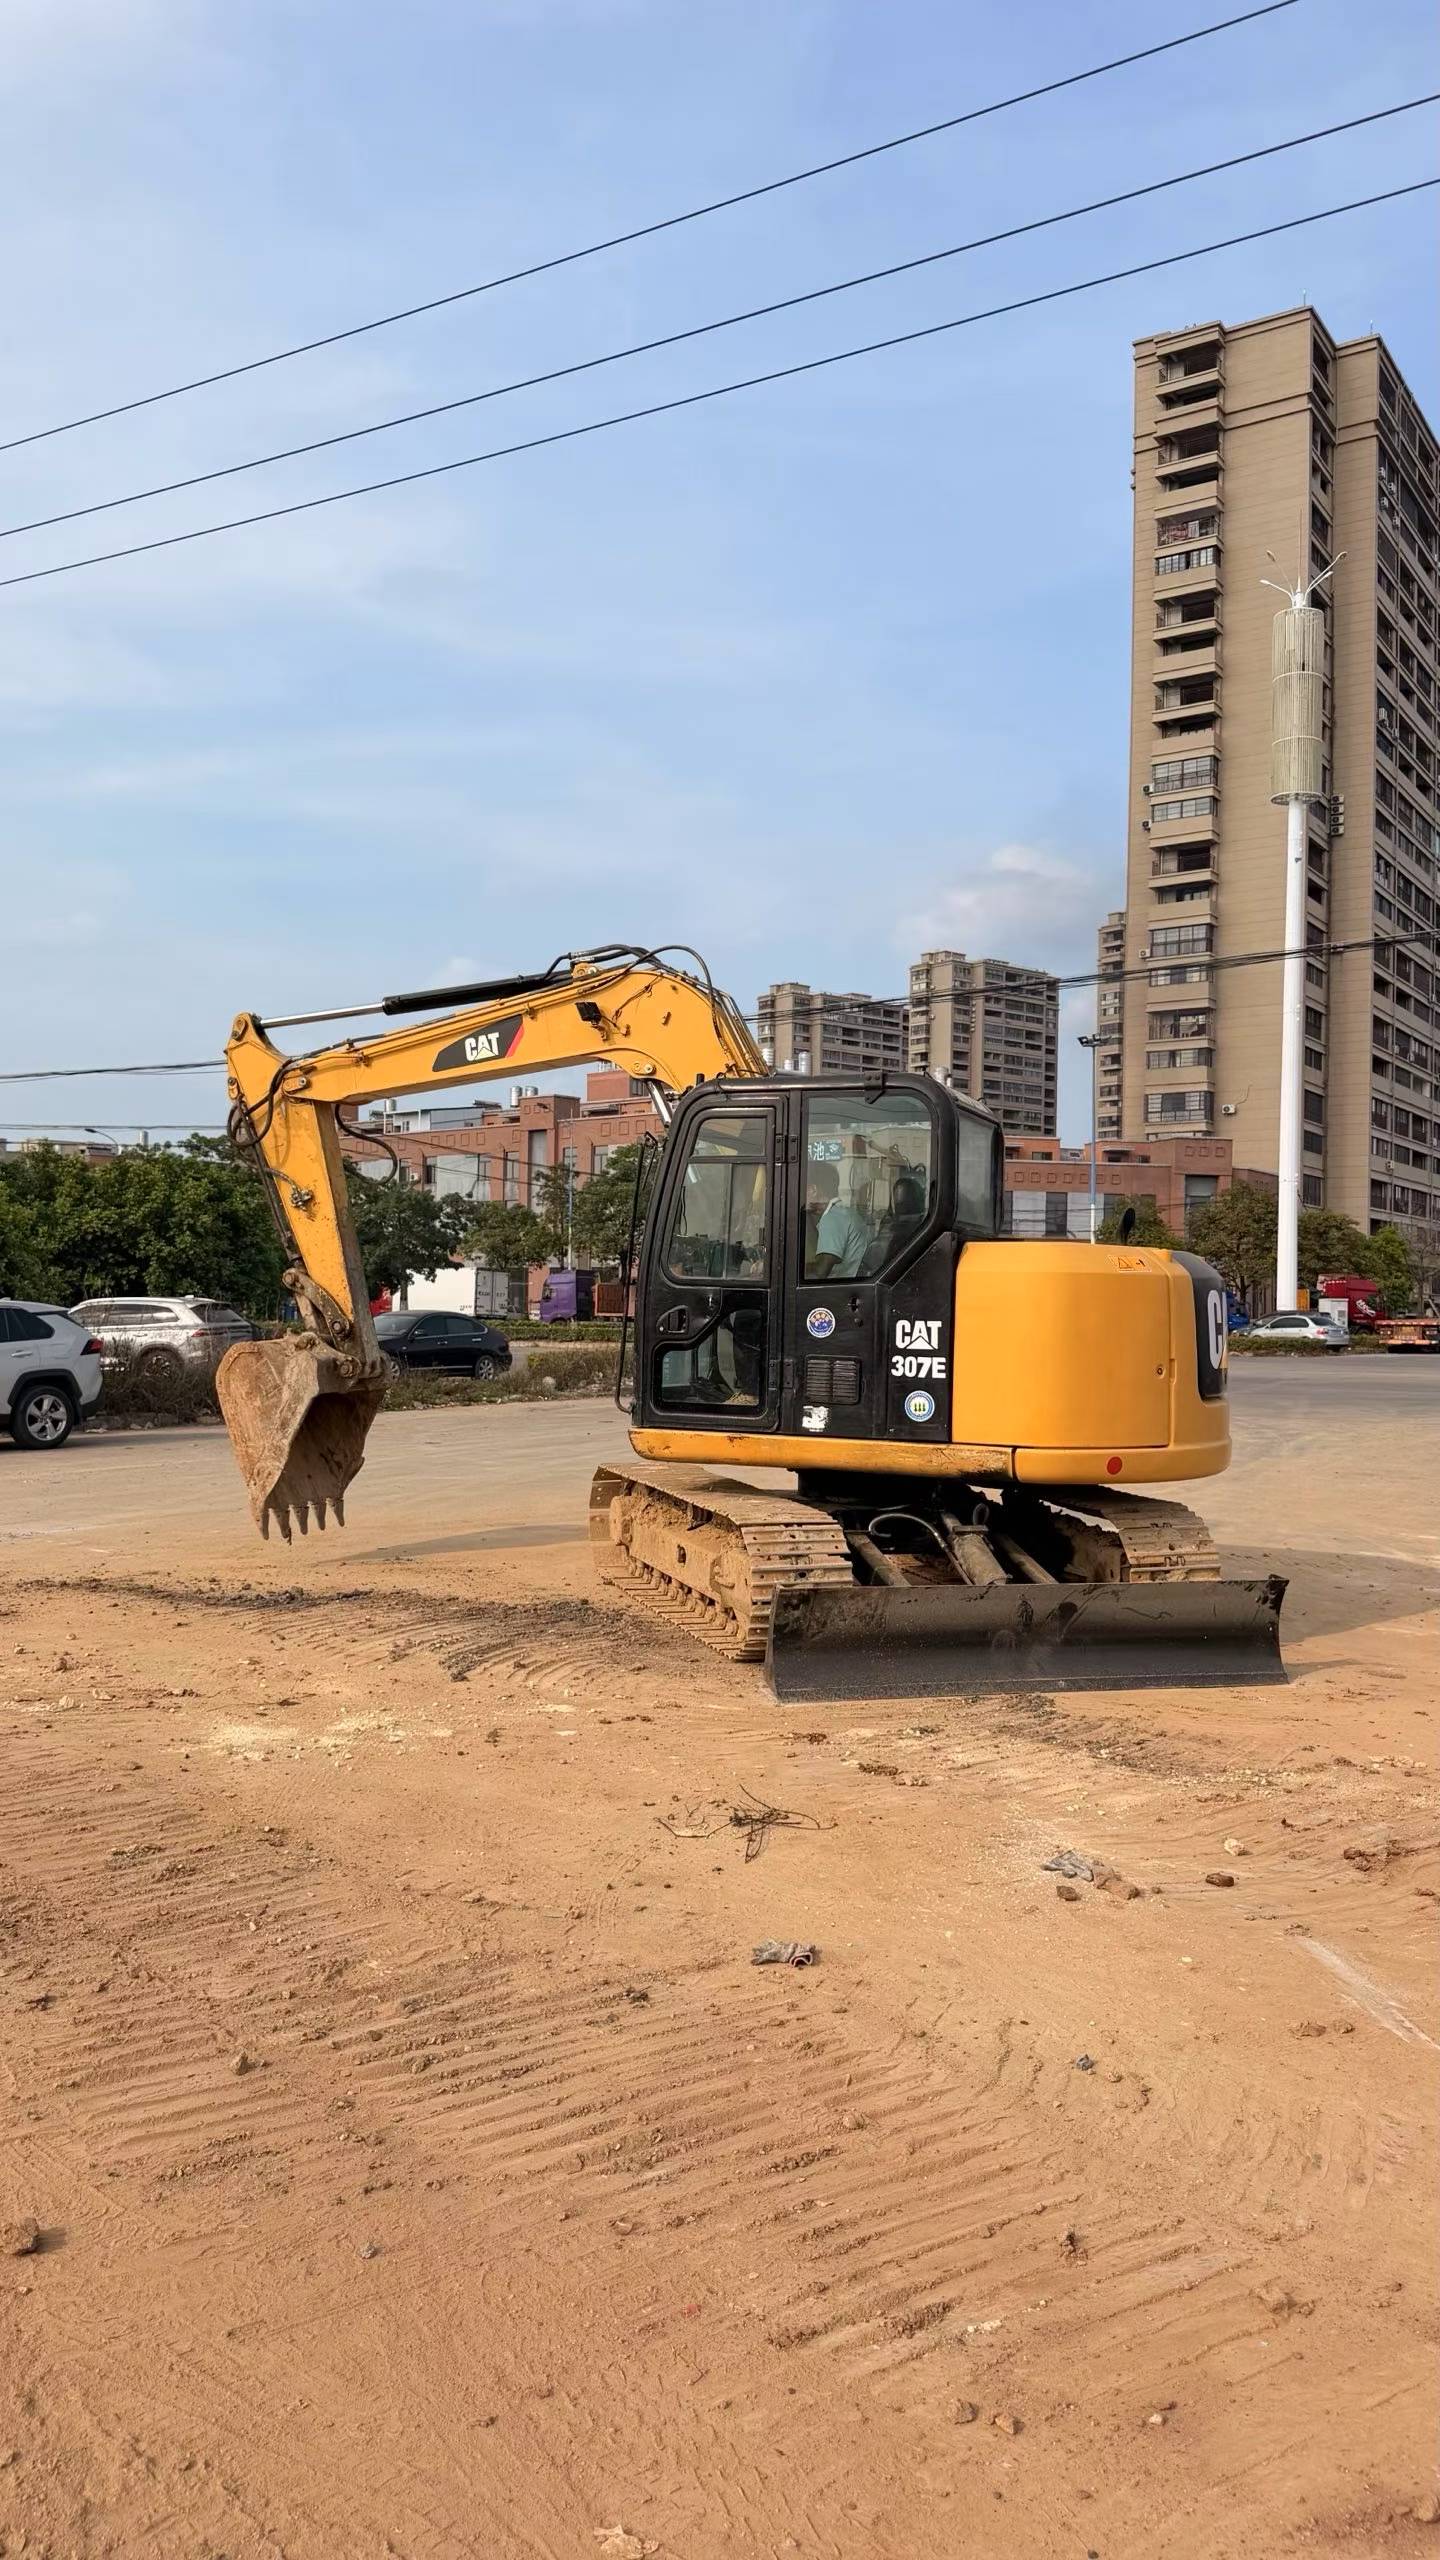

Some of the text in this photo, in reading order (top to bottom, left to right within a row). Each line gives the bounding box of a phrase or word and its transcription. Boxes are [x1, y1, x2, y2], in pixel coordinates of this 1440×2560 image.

[465, 1032, 500, 1062] CAT
[895, 1319, 942, 1350] CAT
[891, 1355, 947, 1379] 307E
